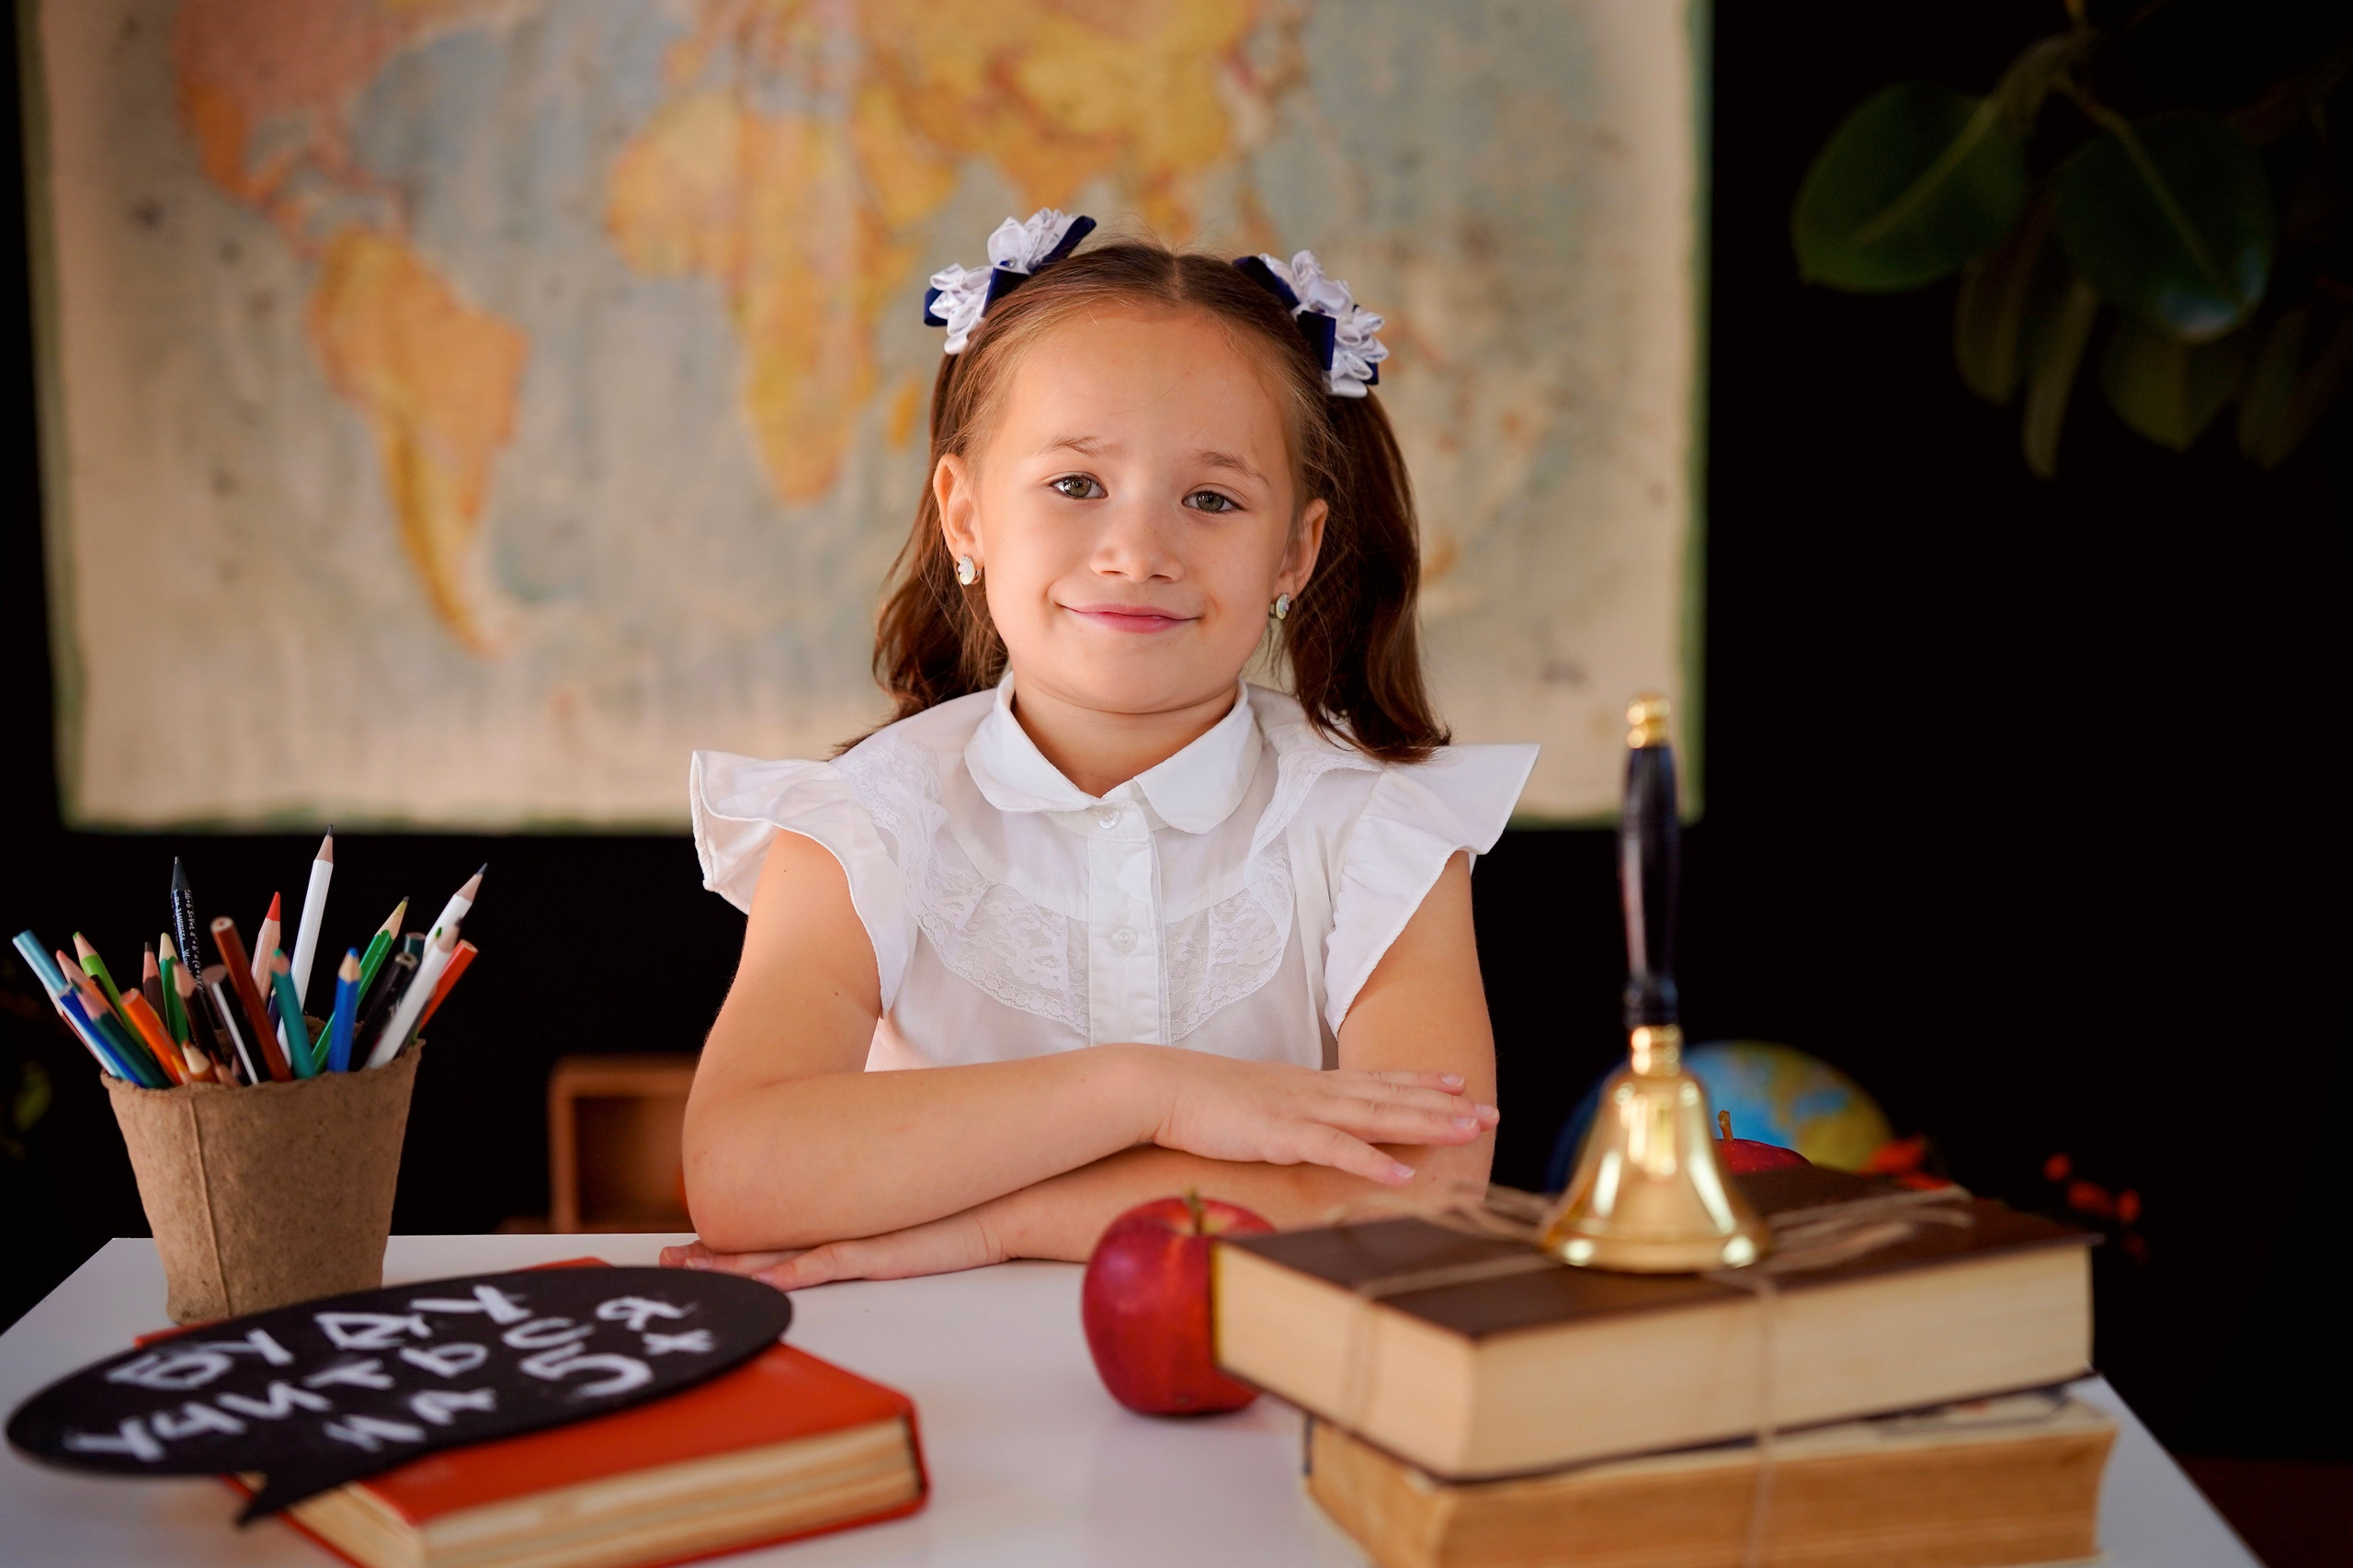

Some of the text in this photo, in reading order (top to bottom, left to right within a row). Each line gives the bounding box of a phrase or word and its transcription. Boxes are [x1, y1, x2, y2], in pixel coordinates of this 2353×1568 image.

[62, 1296, 697, 1461] УЧИТЬСЯ
[106, 1286, 531, 1390] БУДУ
[324, 1388, 498, 1451] НА
